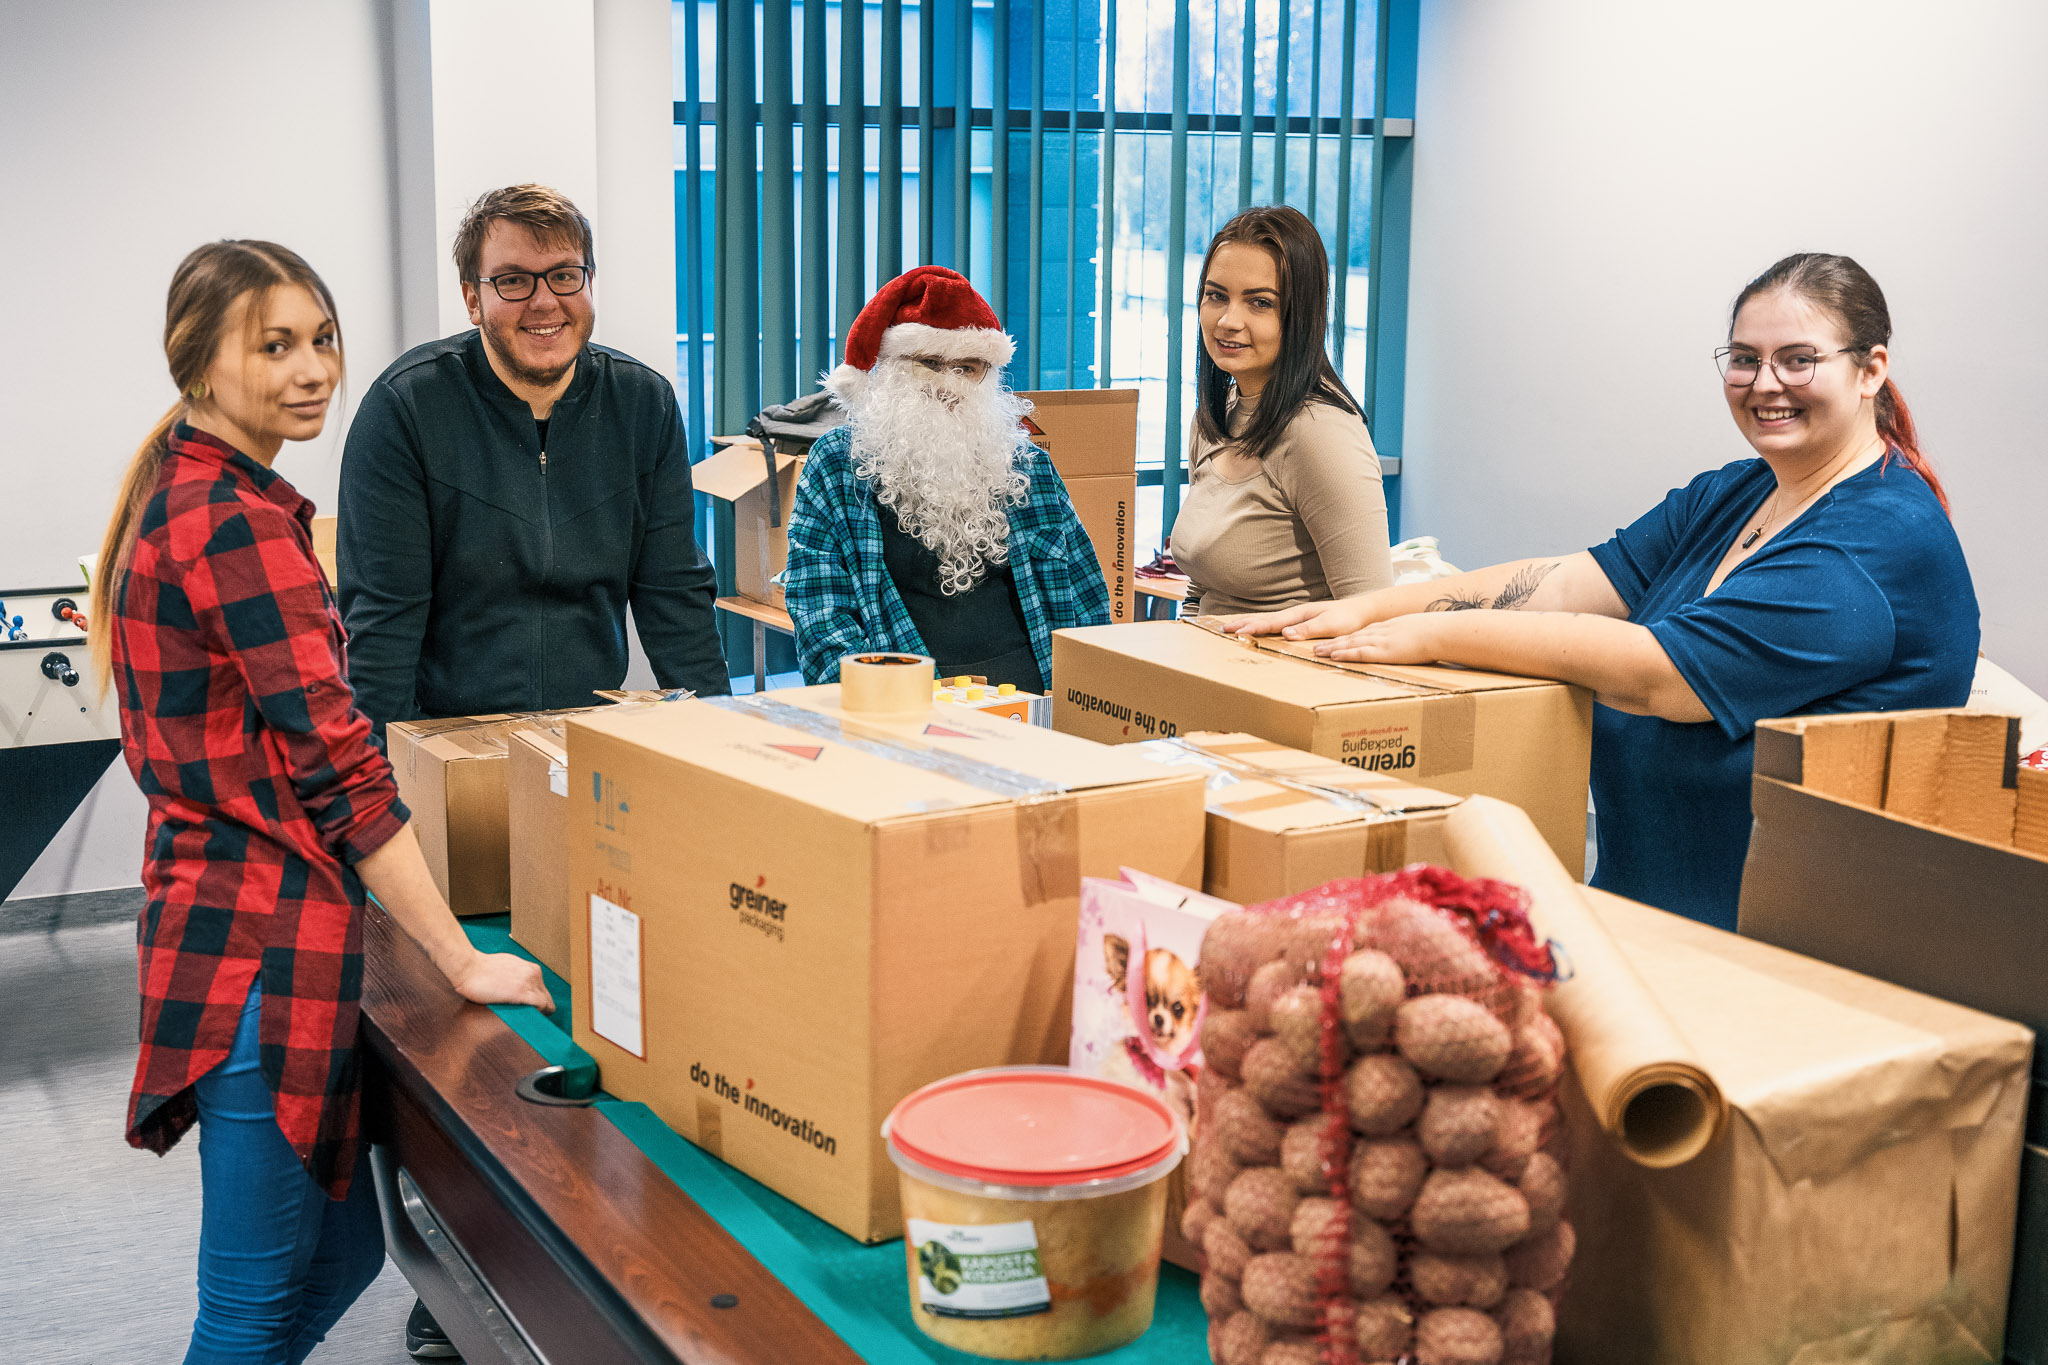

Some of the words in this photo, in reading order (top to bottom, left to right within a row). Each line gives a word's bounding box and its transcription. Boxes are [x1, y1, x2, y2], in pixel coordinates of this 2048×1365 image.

[1112, 500, 1126, 572] innovation
[1114, 575, 1125, 597] the
[1114, 600, 1124, 618] do
[1067, 687, 1132, 736] innovation
[1134, 711, 1156, 735] the
[1159, 720, 1177, 739] do
[1342, 735, 1403, 753] packaging
[729, 874, 787, 923] greiner
[690, 1061, 710, 1088] do
[714, 1073, 741, 1104] the
[744, 1077, 837, 1156] innovation
